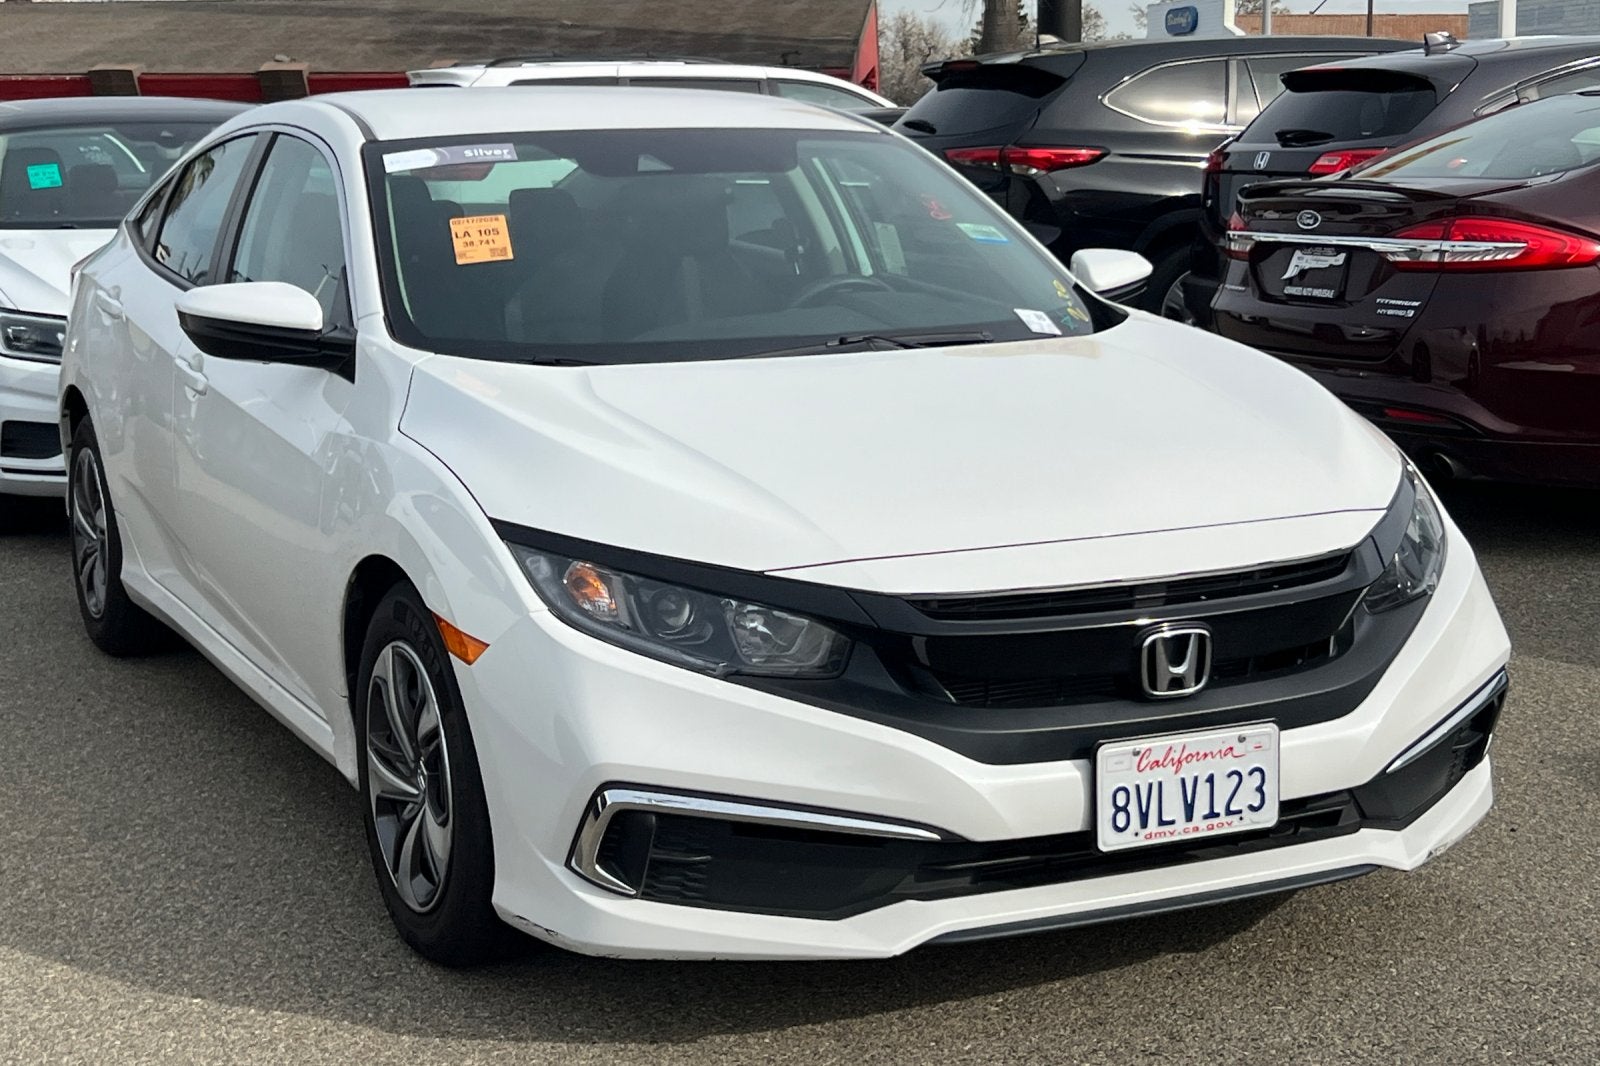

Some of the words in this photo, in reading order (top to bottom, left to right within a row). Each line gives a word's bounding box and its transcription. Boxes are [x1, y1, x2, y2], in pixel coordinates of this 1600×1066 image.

[454, 229, 472, 239] LA
[477, 227, 500, 238] 105
[1136, 742, 1246, 775] California
[1111, 766, 1266, 834] 8VLV123
[1143, 821, 1234, 841] dmv.ca.gov
